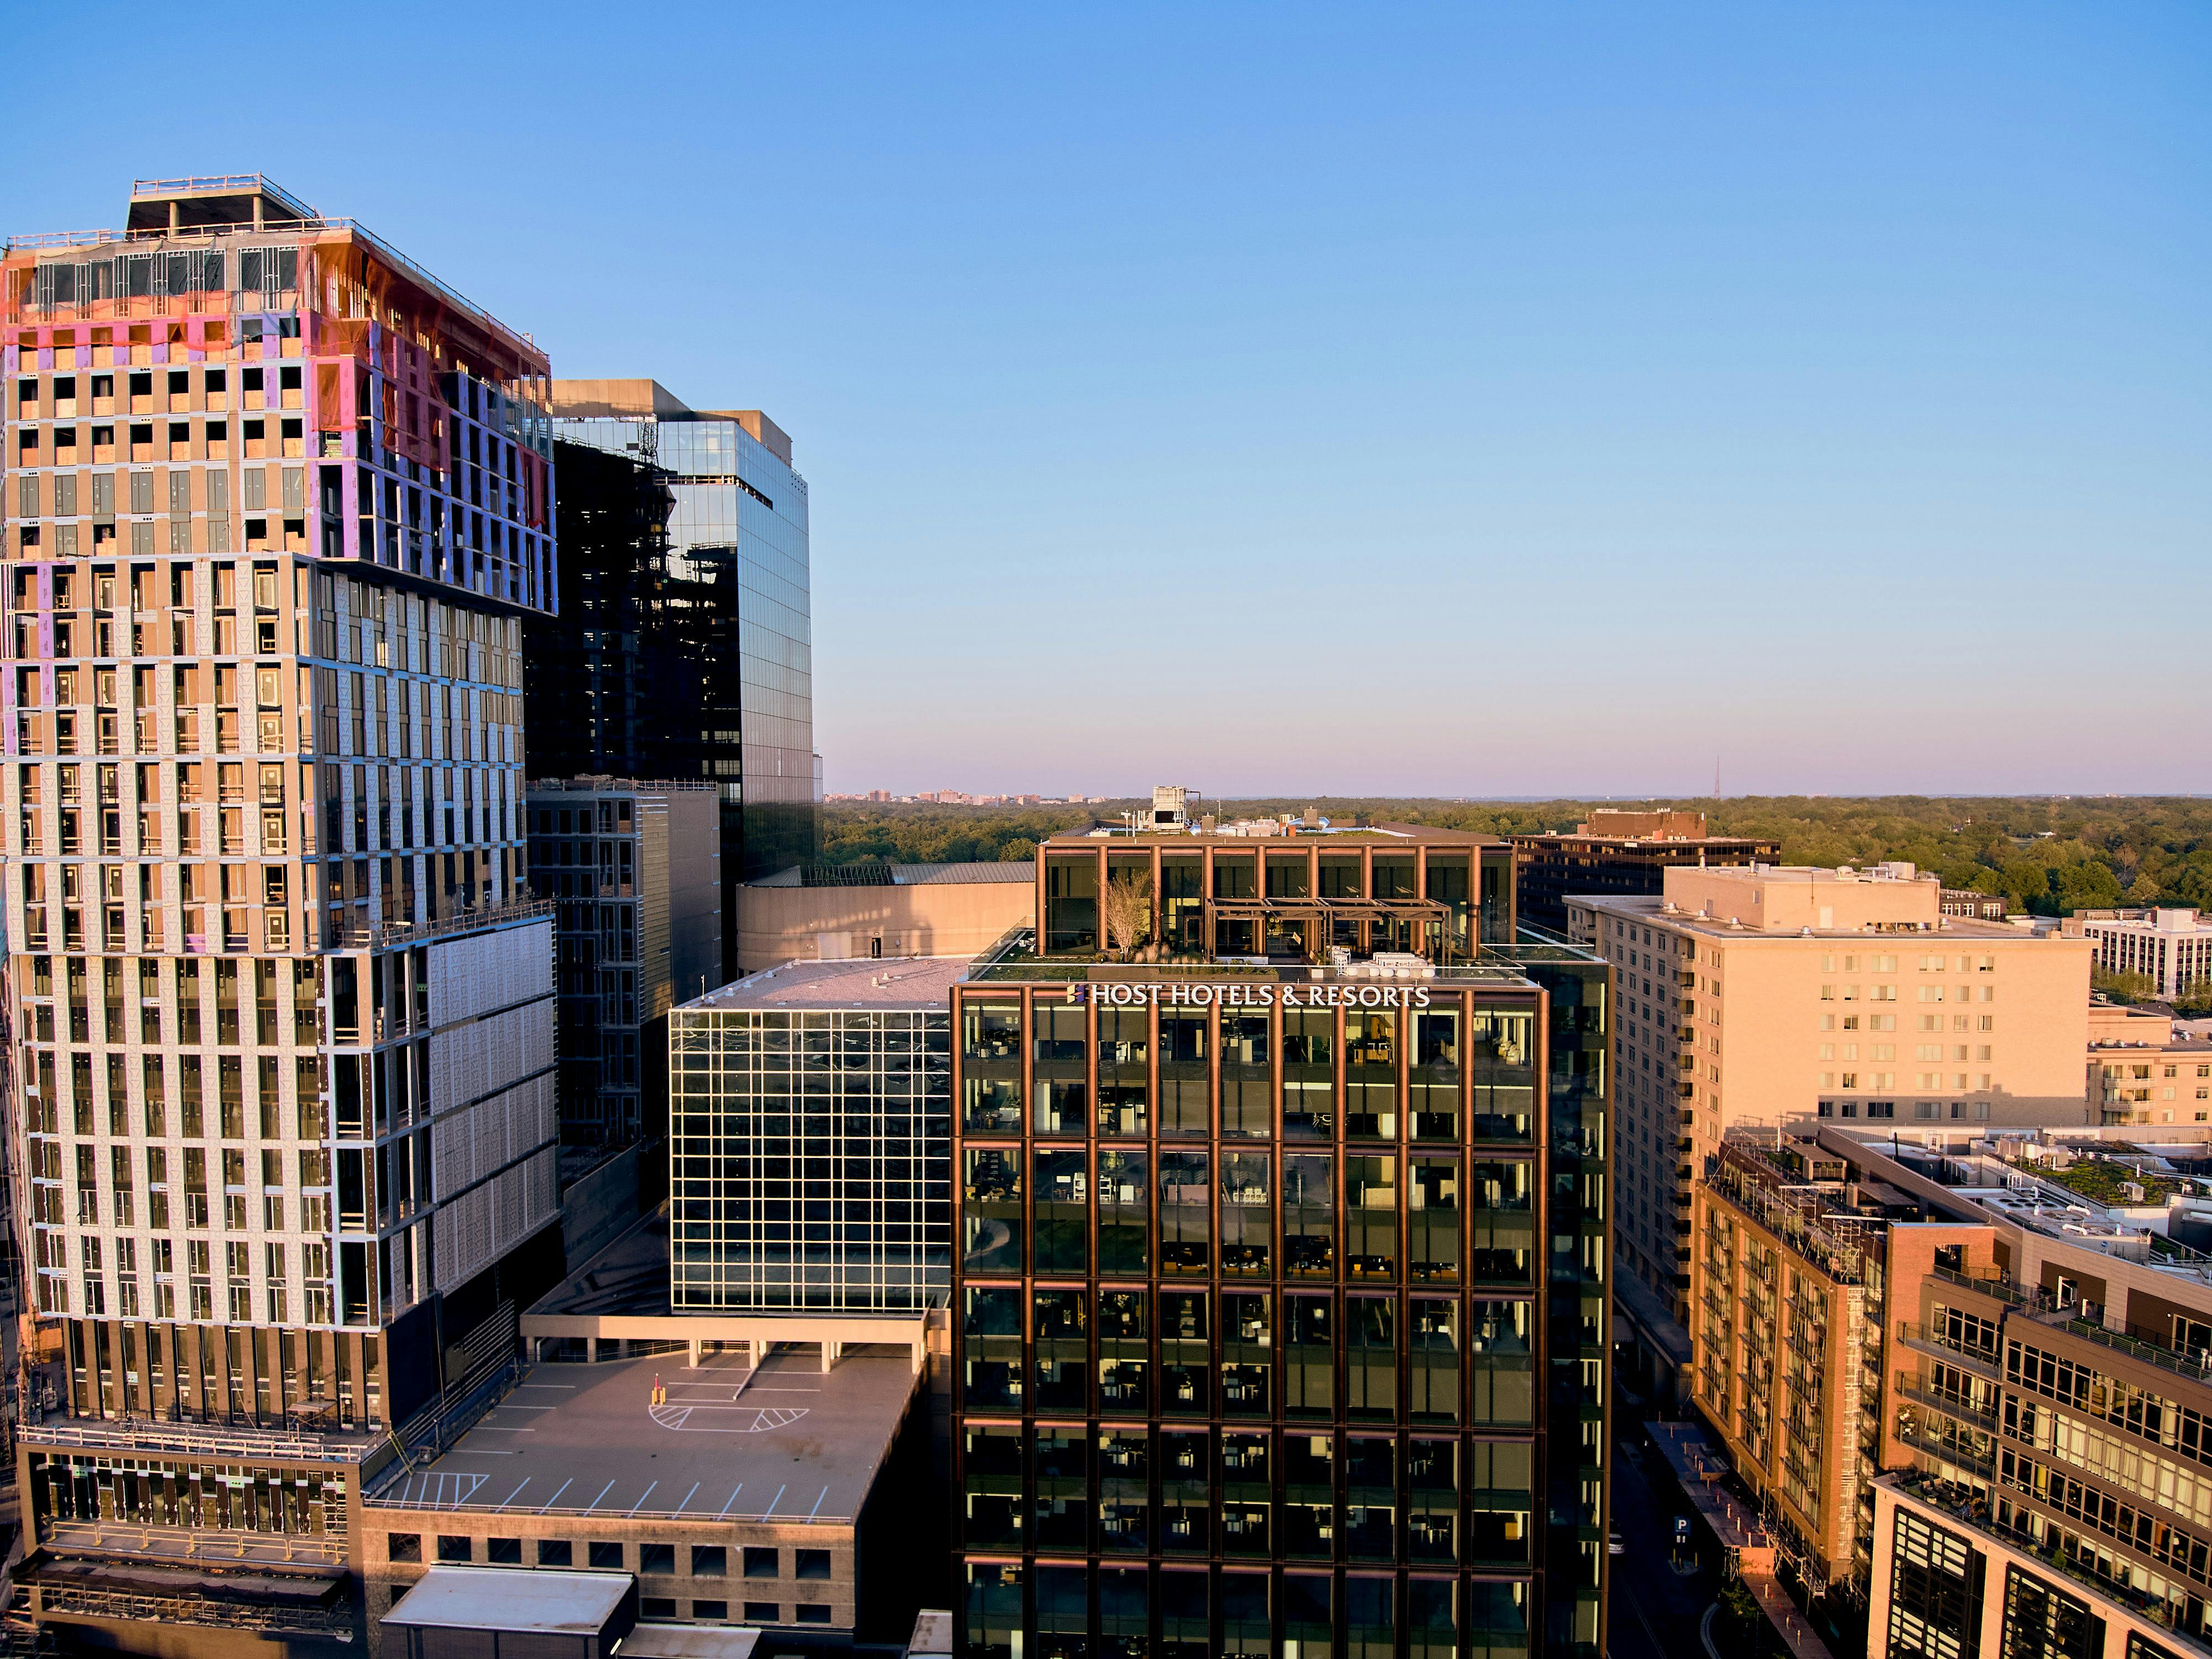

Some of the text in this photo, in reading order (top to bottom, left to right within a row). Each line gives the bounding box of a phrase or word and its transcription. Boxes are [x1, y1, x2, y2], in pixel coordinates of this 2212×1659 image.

[1092, 984, 1430, 1007] HOST HOTELS & RESORTS
[1678, 1519, 1687, 1530] P
